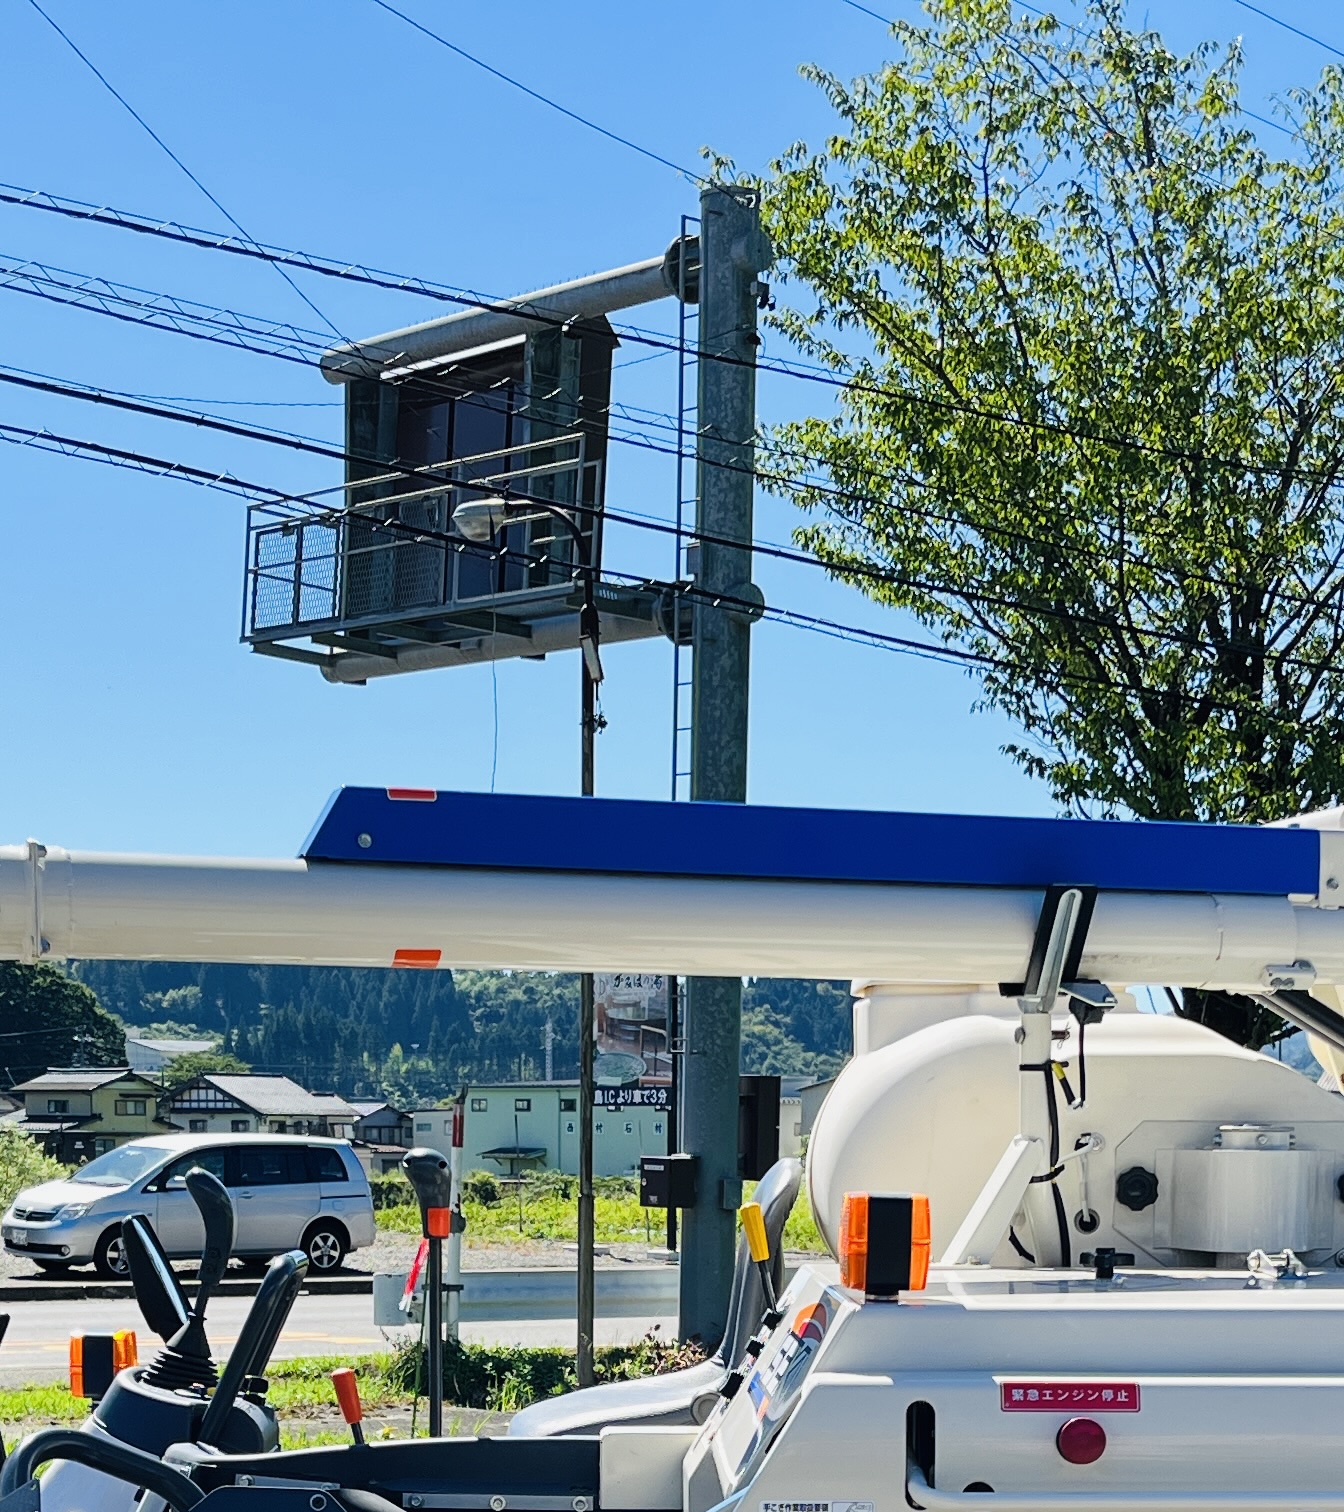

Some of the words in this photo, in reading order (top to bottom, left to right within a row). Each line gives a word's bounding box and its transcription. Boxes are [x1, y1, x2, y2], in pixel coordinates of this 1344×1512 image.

[1010, 1387, 1131, 1403] 緊急エンジン停止
